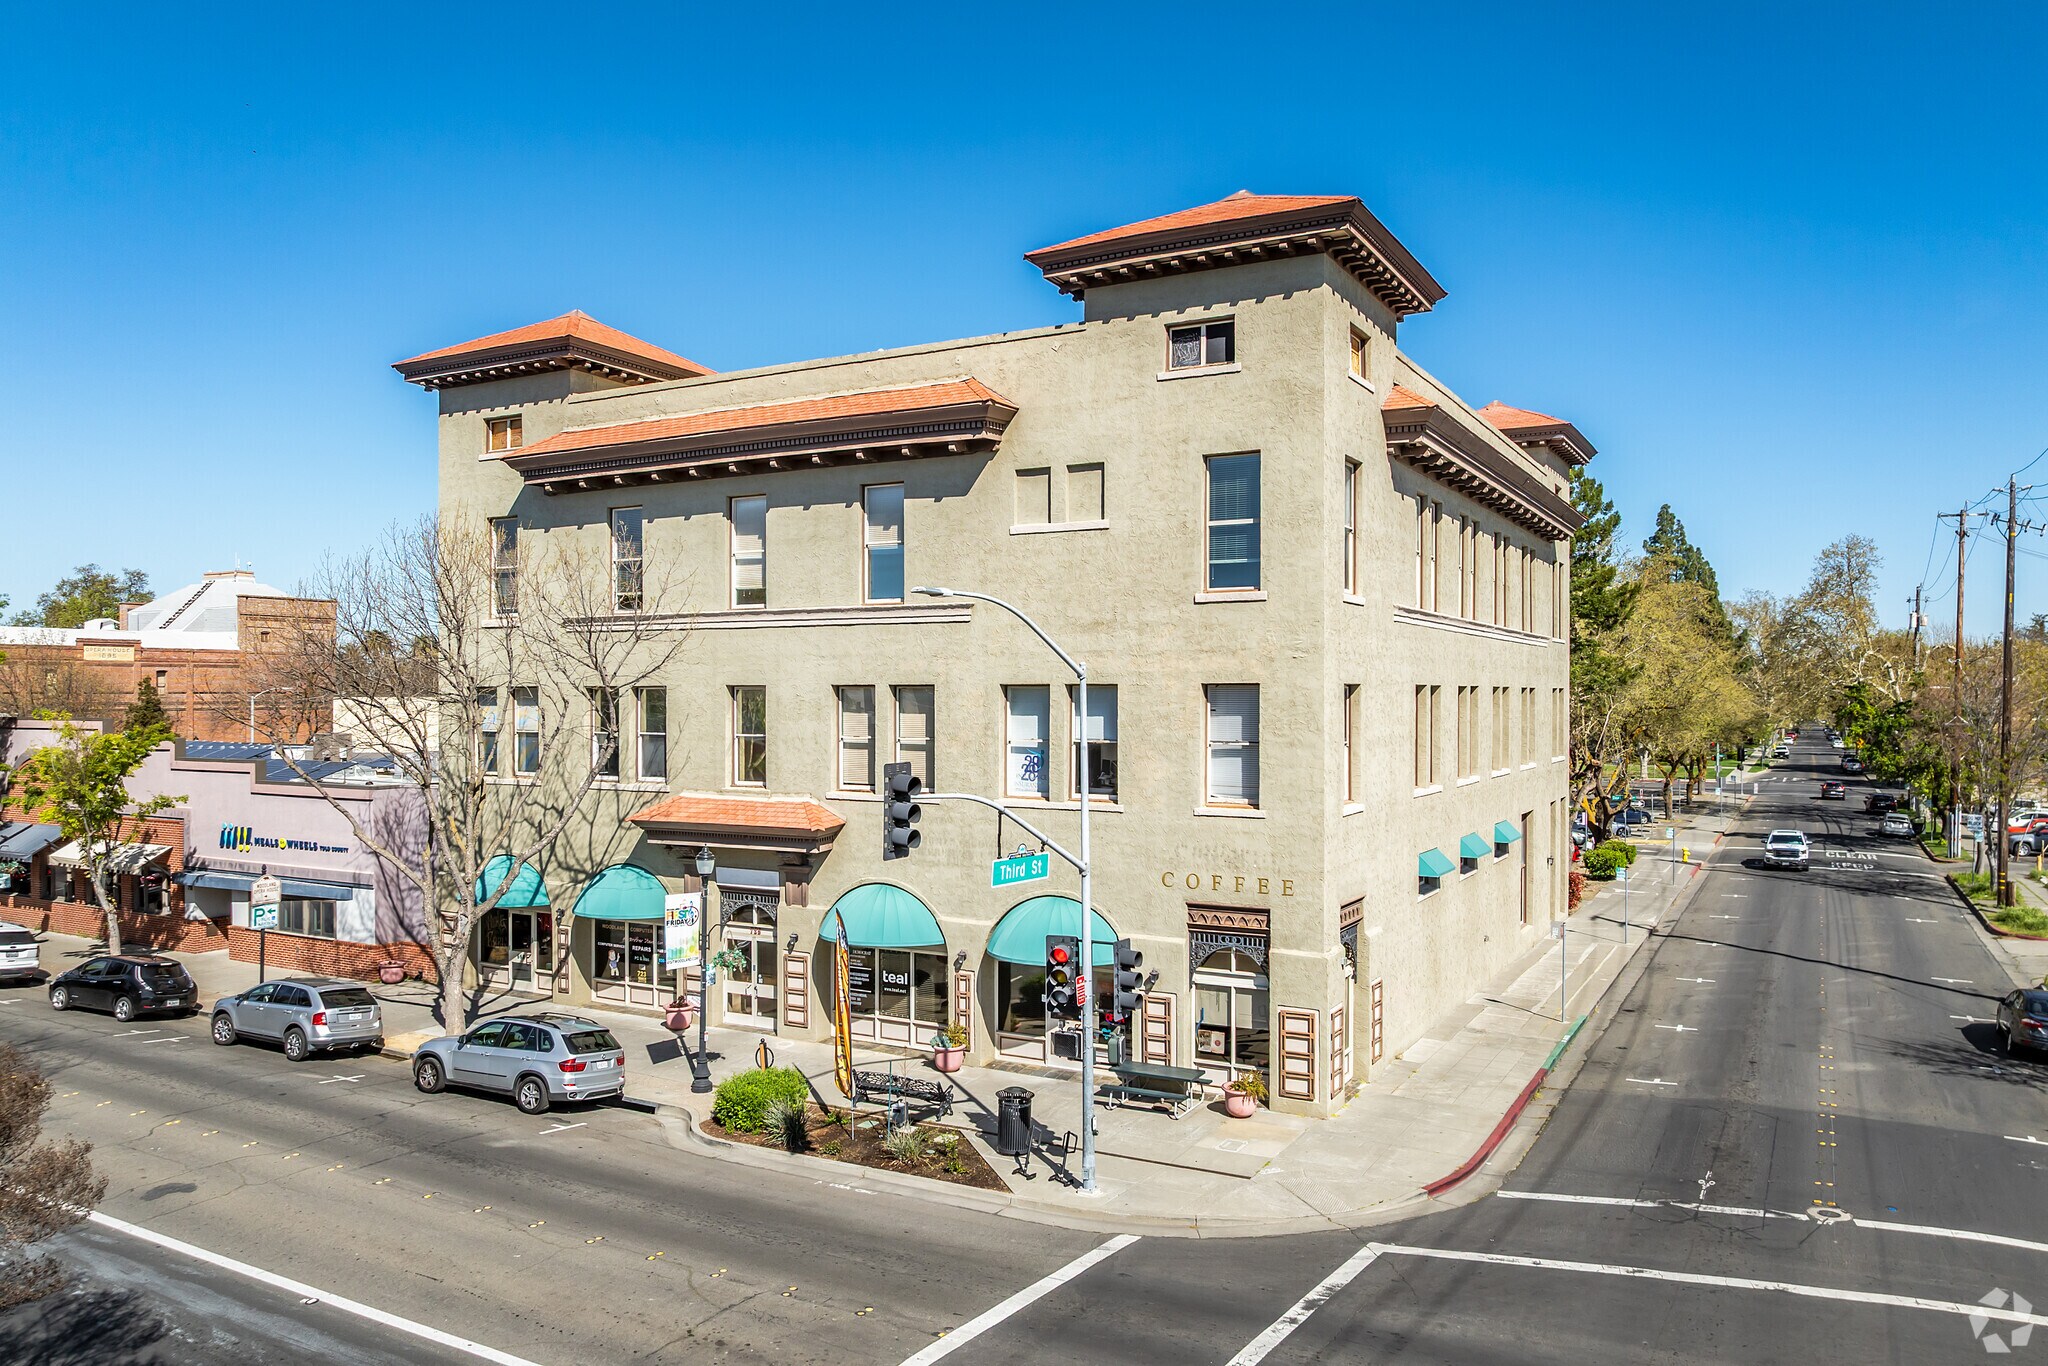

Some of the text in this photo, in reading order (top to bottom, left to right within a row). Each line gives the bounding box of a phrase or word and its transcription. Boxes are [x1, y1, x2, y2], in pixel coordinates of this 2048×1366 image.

[254, 837, 280, 849] MEALS
[286, 839, 318, 852] WHEELS
[1825, 851, 1878, 860] CLEAR
[1000, 859, 1043, 880] Third St
[1161, 871, 1295, 897] COFFEE
[253, 908, 265, 926] P
[632, 945, 652, 953] REPAIRS
[882, 970, 908, 985] teal
